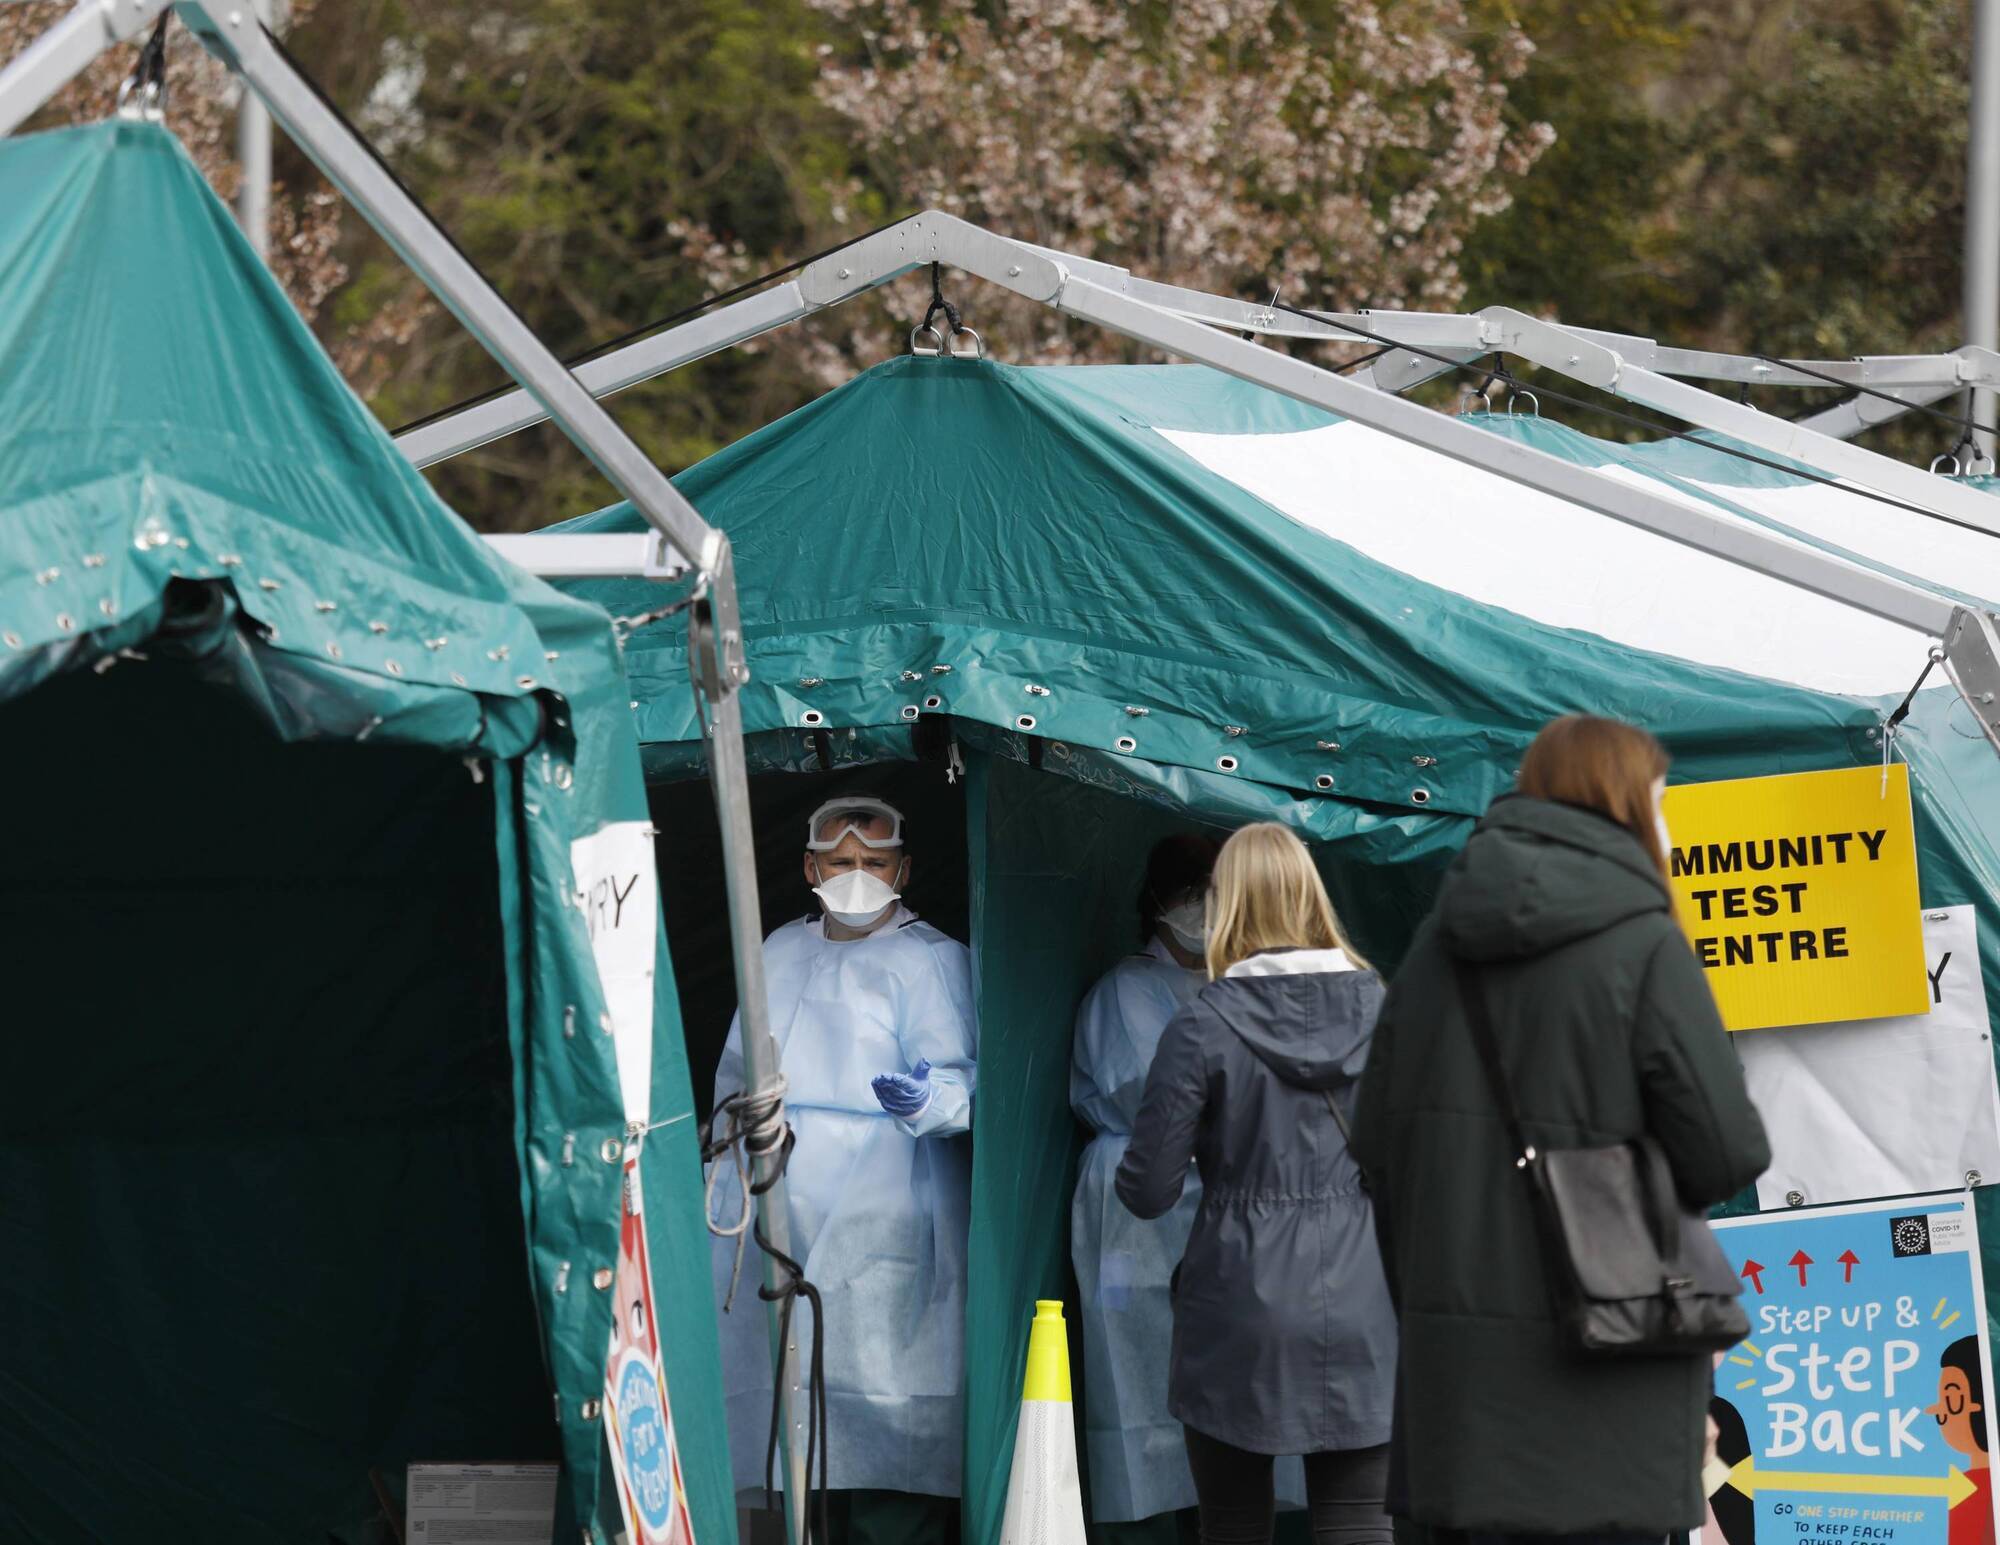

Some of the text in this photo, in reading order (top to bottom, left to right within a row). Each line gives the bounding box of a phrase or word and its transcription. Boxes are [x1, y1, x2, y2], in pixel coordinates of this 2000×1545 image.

[1671, 829, 1887, 878] MMUNITY
[1691, 882, 1808, 921] TEST
[1694, 927, 1849, 969] ENTRE
[1931, 1225, 1960, 1233] COVID-19
[1895, 1296, 1920, 1328] &
[1773, 1503, 1925, 1523] GO ONE STEP FURTHER
[1794, 1521, 1894, 1539] TO KEEP EACH
